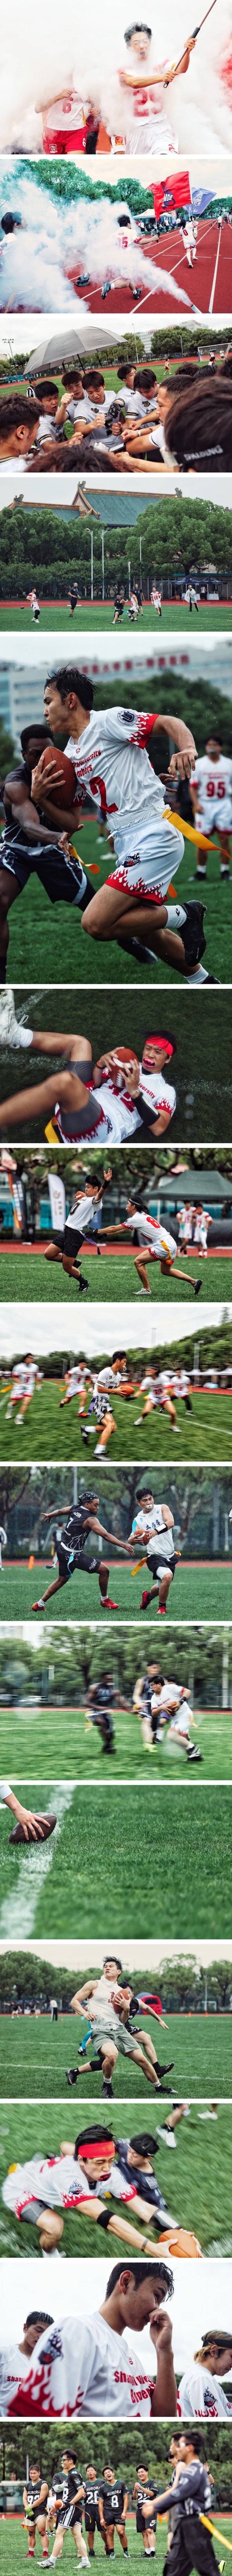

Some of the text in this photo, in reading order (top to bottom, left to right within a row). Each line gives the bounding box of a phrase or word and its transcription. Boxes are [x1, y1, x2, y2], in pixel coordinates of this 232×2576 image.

[62, 97, 73, 113] 6
[82, 138, 86, 147] 6
[183, 445, 223, 461] SPALDING
[206, 781, 226, 798] 95
[138, 1083, 155, 1099] iversity
[146, 1217, 160, 1228] 8
[67, 1517, 74, 1529] 7
[111, 2495, 119, 2507] 8
